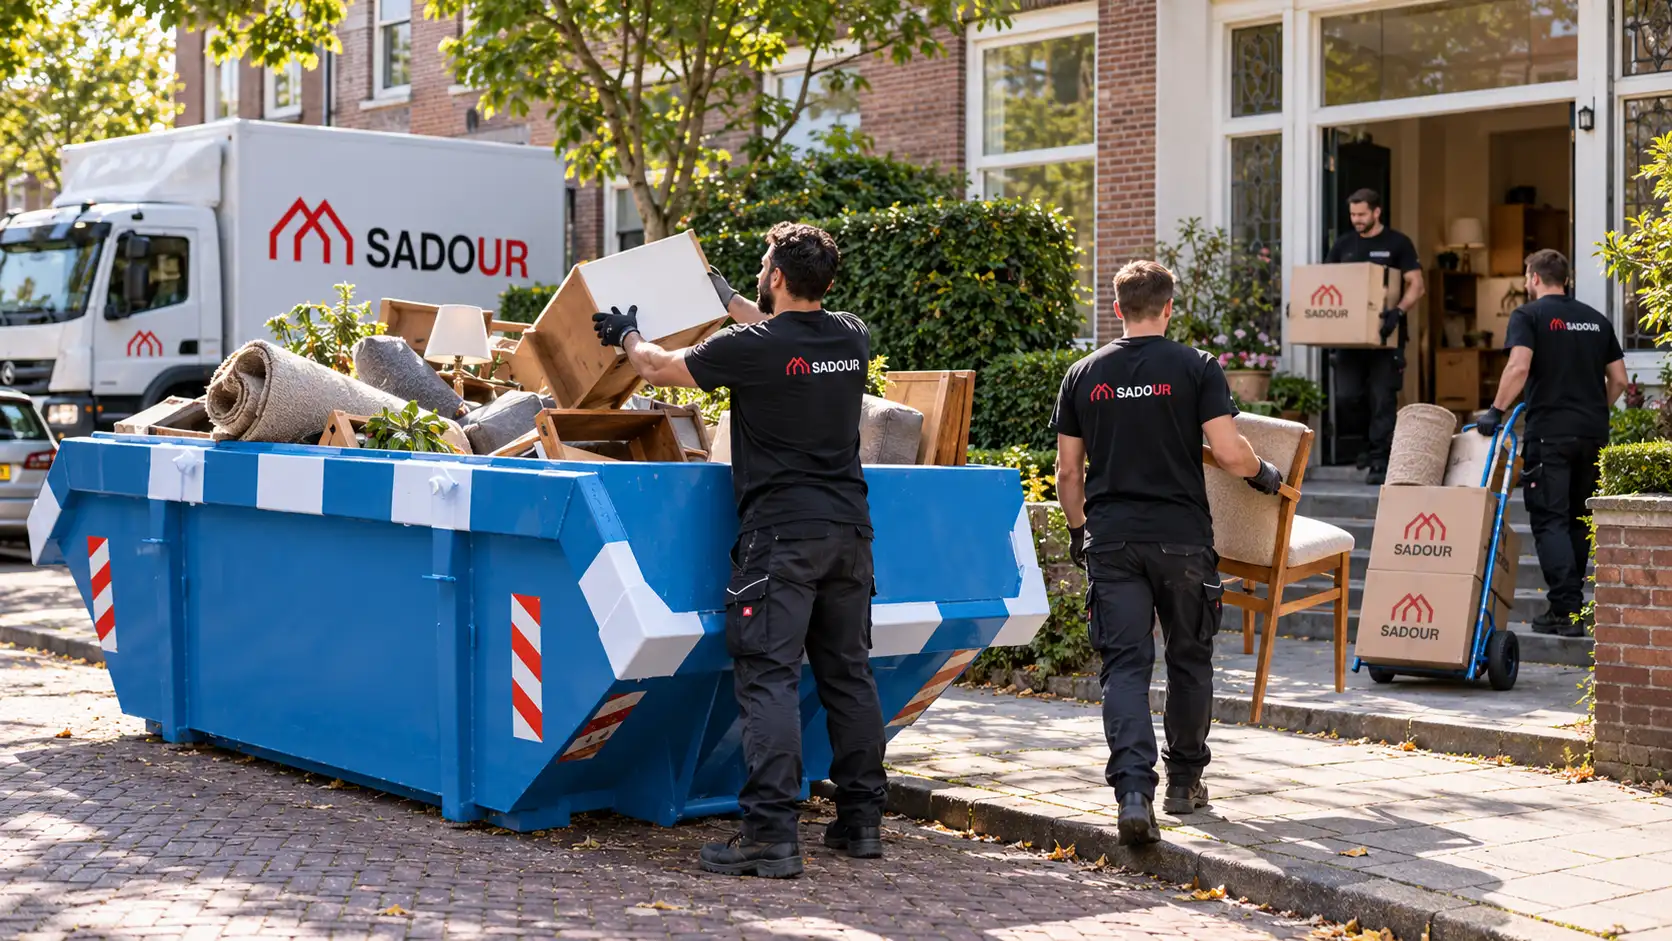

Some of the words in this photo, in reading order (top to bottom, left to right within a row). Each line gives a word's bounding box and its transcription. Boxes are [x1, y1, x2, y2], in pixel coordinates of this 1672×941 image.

[366, 227, 529, 279] SADOUR
[1305, 309, 1348, 318] SADOUR
[1566, 322, 1600, 332] SADOUR
[812, 359, 860, 373] SADOUR
[1116, 384, 1171, 398] SADOUR
[1394, 543, 1452, 557] SADOUR
[1381, 624, 1439, 640] SADOUR
